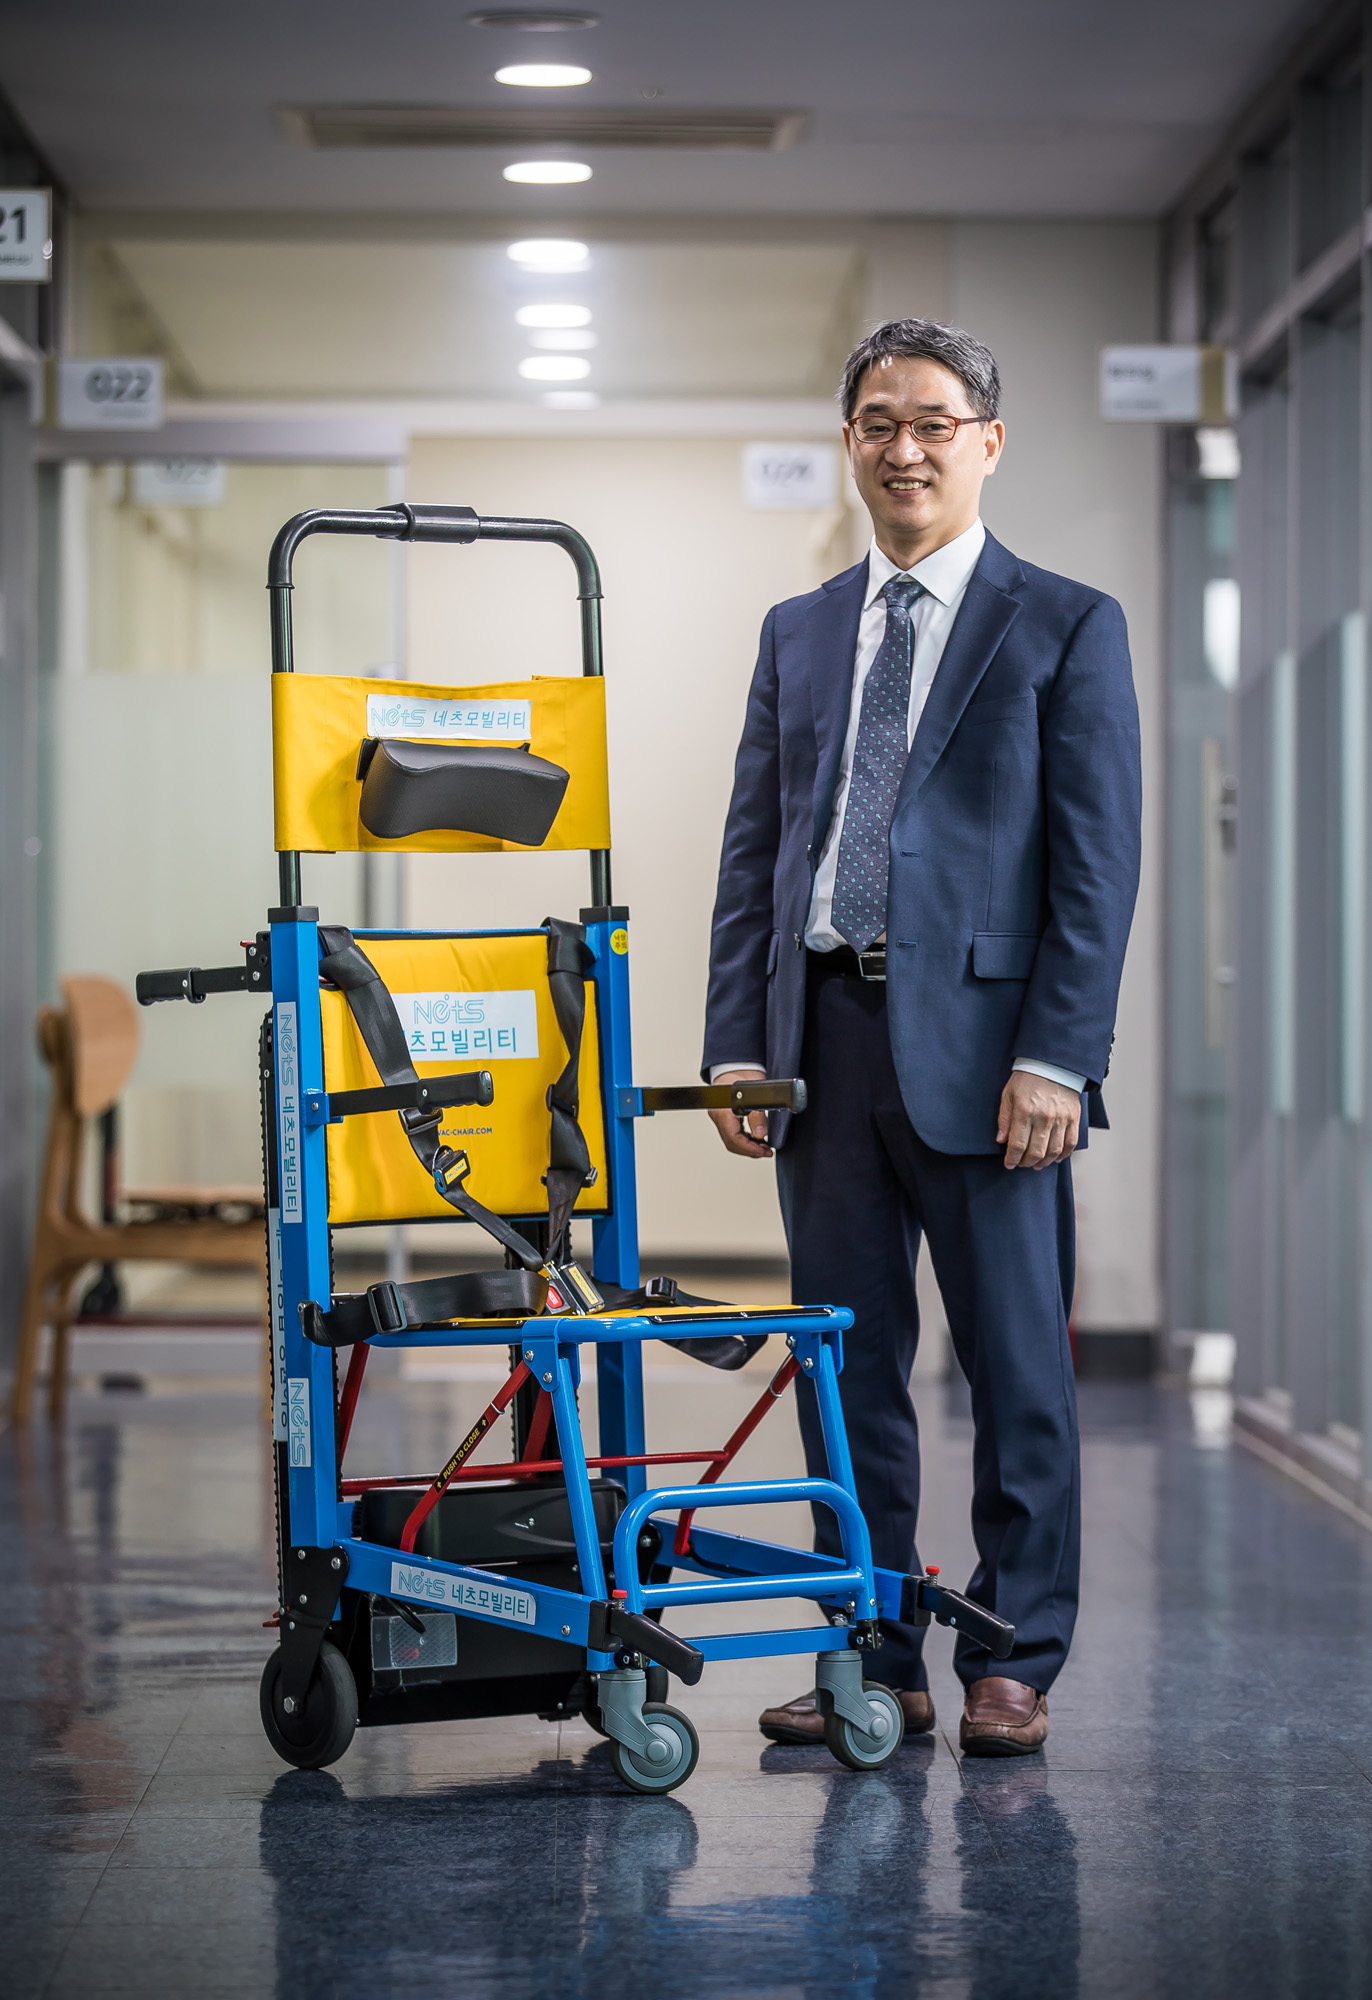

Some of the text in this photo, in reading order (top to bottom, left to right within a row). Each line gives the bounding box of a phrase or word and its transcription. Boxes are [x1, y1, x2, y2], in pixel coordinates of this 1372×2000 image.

[432, 710, 527, 730] 네츠모빌리티
[403, 1027, 518, 1055] 츠모빌리티
[282, 1096, 298, 1213] 네츠모빌리티
[443, 1428, 481, 1480] PUSH TO CLOSE
[451, 1583, 530, 1619] 네츠모빌리티
